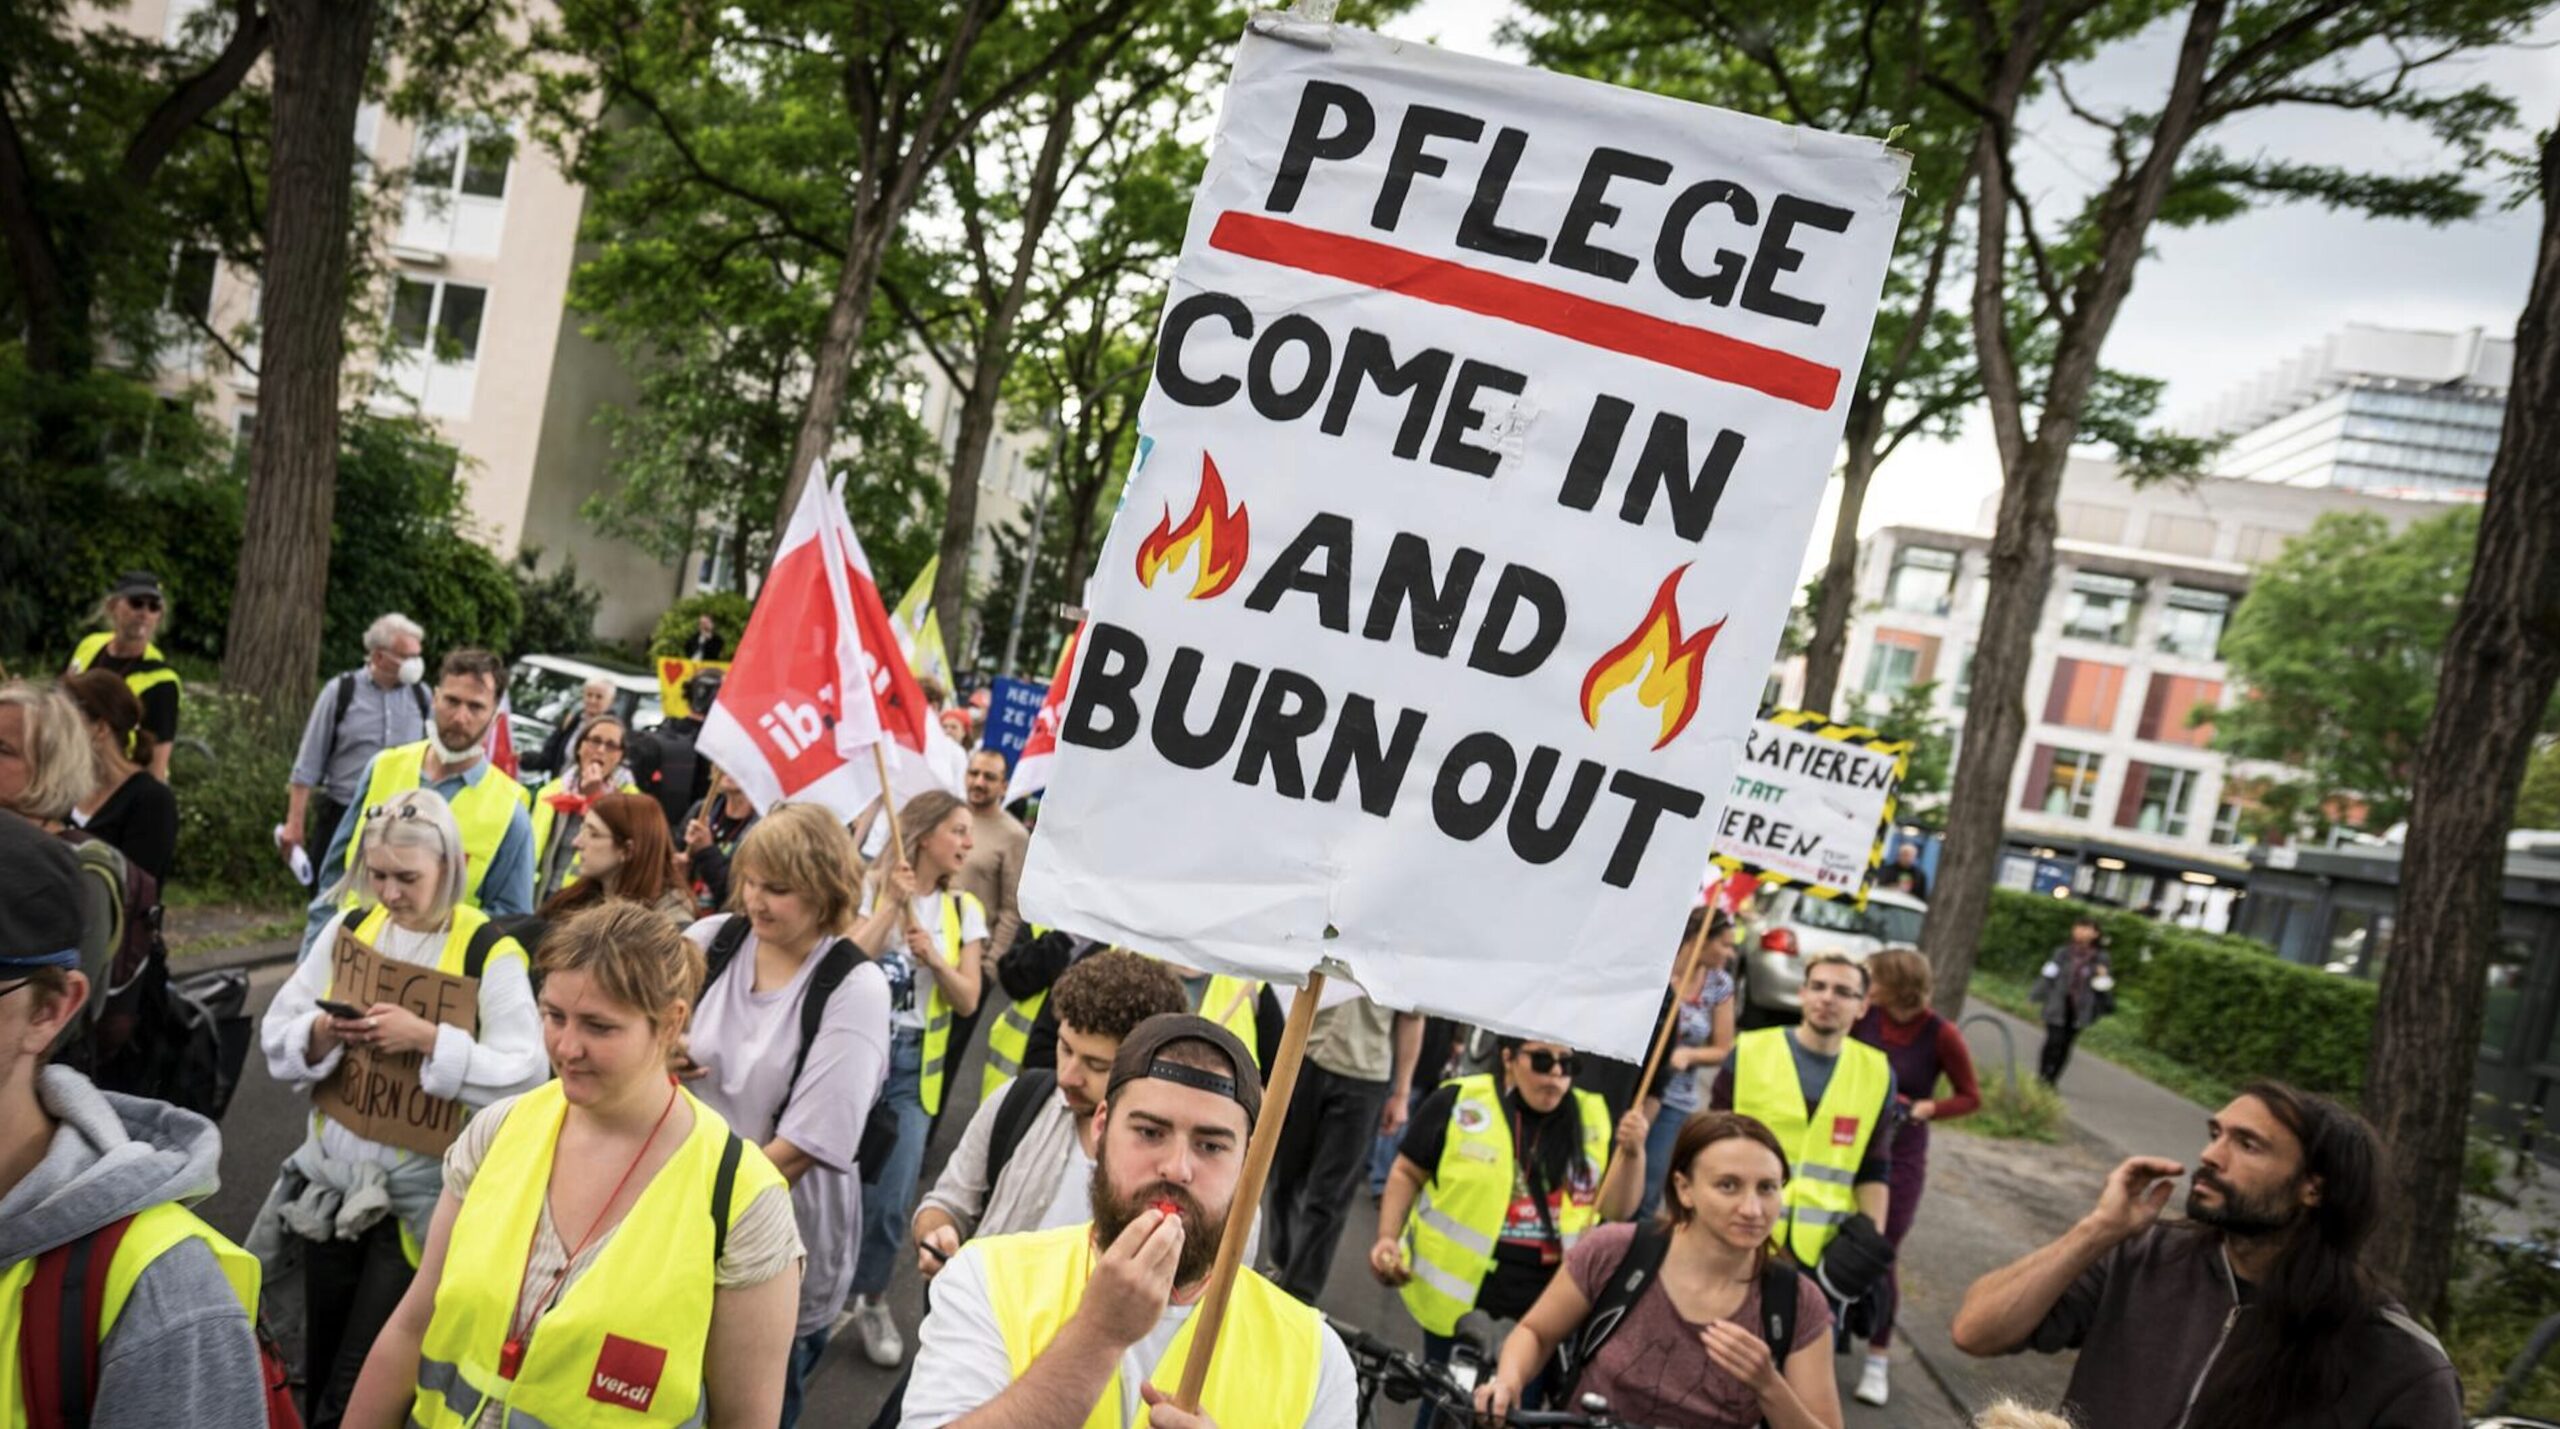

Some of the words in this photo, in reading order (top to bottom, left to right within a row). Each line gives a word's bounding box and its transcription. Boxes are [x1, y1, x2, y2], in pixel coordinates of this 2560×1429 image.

[1265, 80, 1855, 327] PFLEGE
[1155, 292, 1528, 479] COME
[1557, 393, 1746, 543] IN
[1244, 512, 1568, 678] AND
[1061, 622, 1428, 818] BURN
[1431, 732, 1706, 889] OUT
[1730, 776, 1788, 804] TATT
[336, 937, 461, 1025] PFLEGE
[341, 1057, 404, 1119] BURN
[407, 1084, 454, 1133] OUT
[596, 1372, 651, 1404] ver.di
